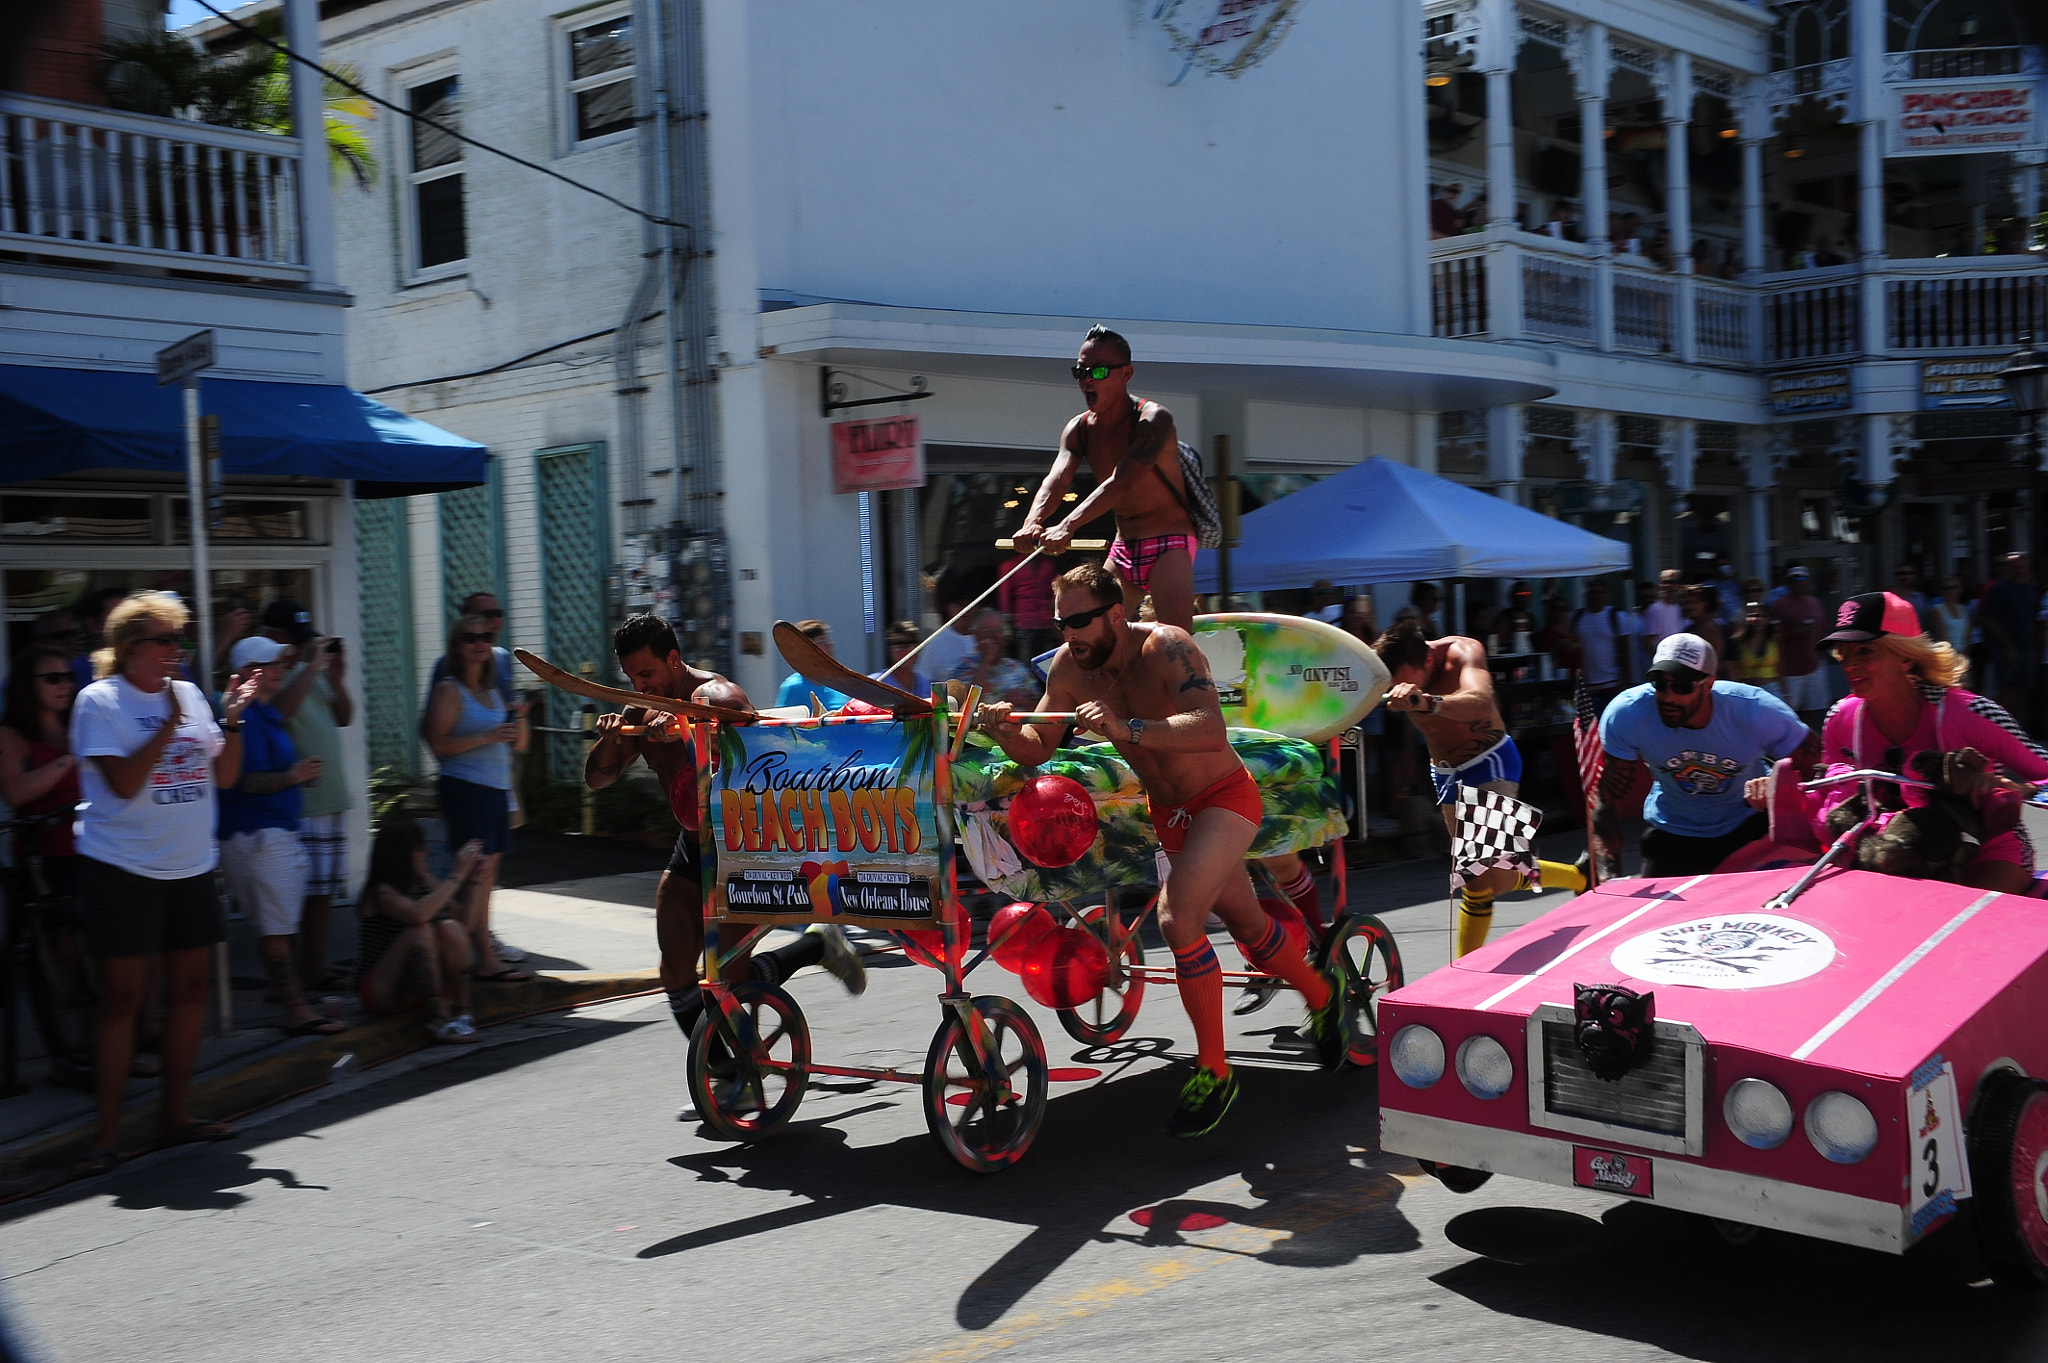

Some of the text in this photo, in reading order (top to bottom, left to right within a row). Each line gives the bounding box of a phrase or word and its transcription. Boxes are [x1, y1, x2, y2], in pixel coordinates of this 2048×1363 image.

[1303, 666, 1350, 682] ISLAND
[745, 750, 896, 796] Bourbon
[720, 787, 922, 854] BEACH BOYS
[867, 873, 883, 882] DUVAL
[887, 873, 897, 882] KEY
[728, 883, 809, 905] Bourbon St. Pub
[840, 886, 930, 911] New Orleans House
[1661, 922, 1818, 945] GAS MONKEY
[1922, 1137, 1940, 1198] 3
